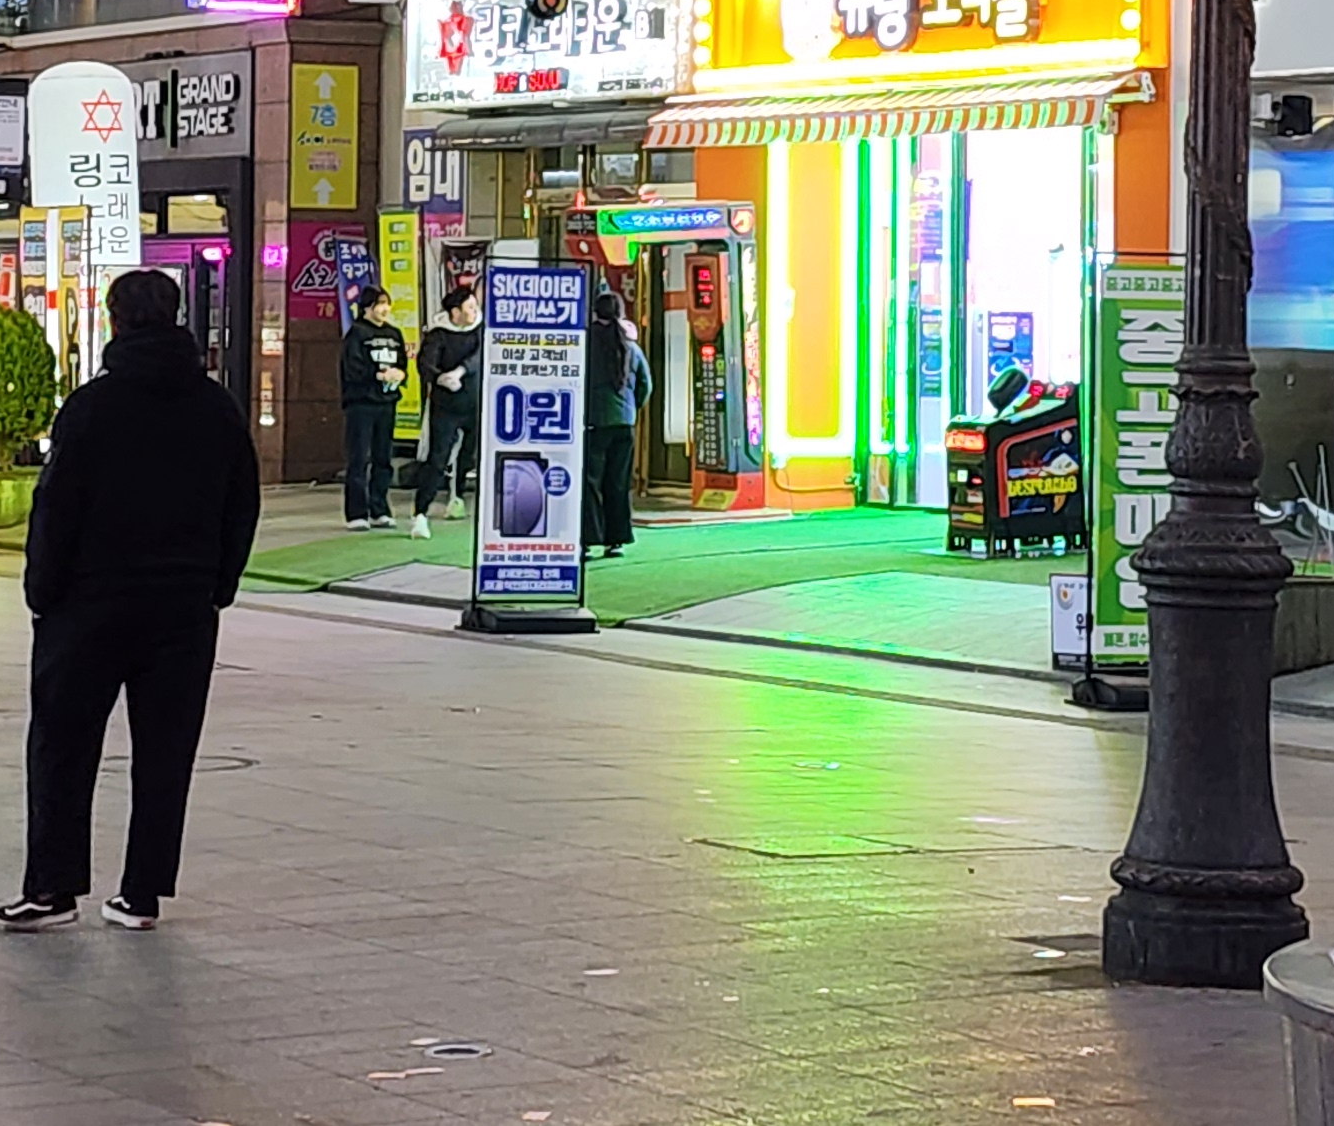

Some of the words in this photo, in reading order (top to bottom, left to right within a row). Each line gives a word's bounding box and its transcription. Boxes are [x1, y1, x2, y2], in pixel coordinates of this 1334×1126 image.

[176, 74, 237, 106] GRAND
[176, 108, 233, 137] STAGE
[69, 152, 132, 189] 링코
[492, 273, 582, 299] SK데이터
[495, 299, 578, 325] 함께쓰기
[502, 348, 525, 361] 이상
[495, 384, 575, 445] 0원
